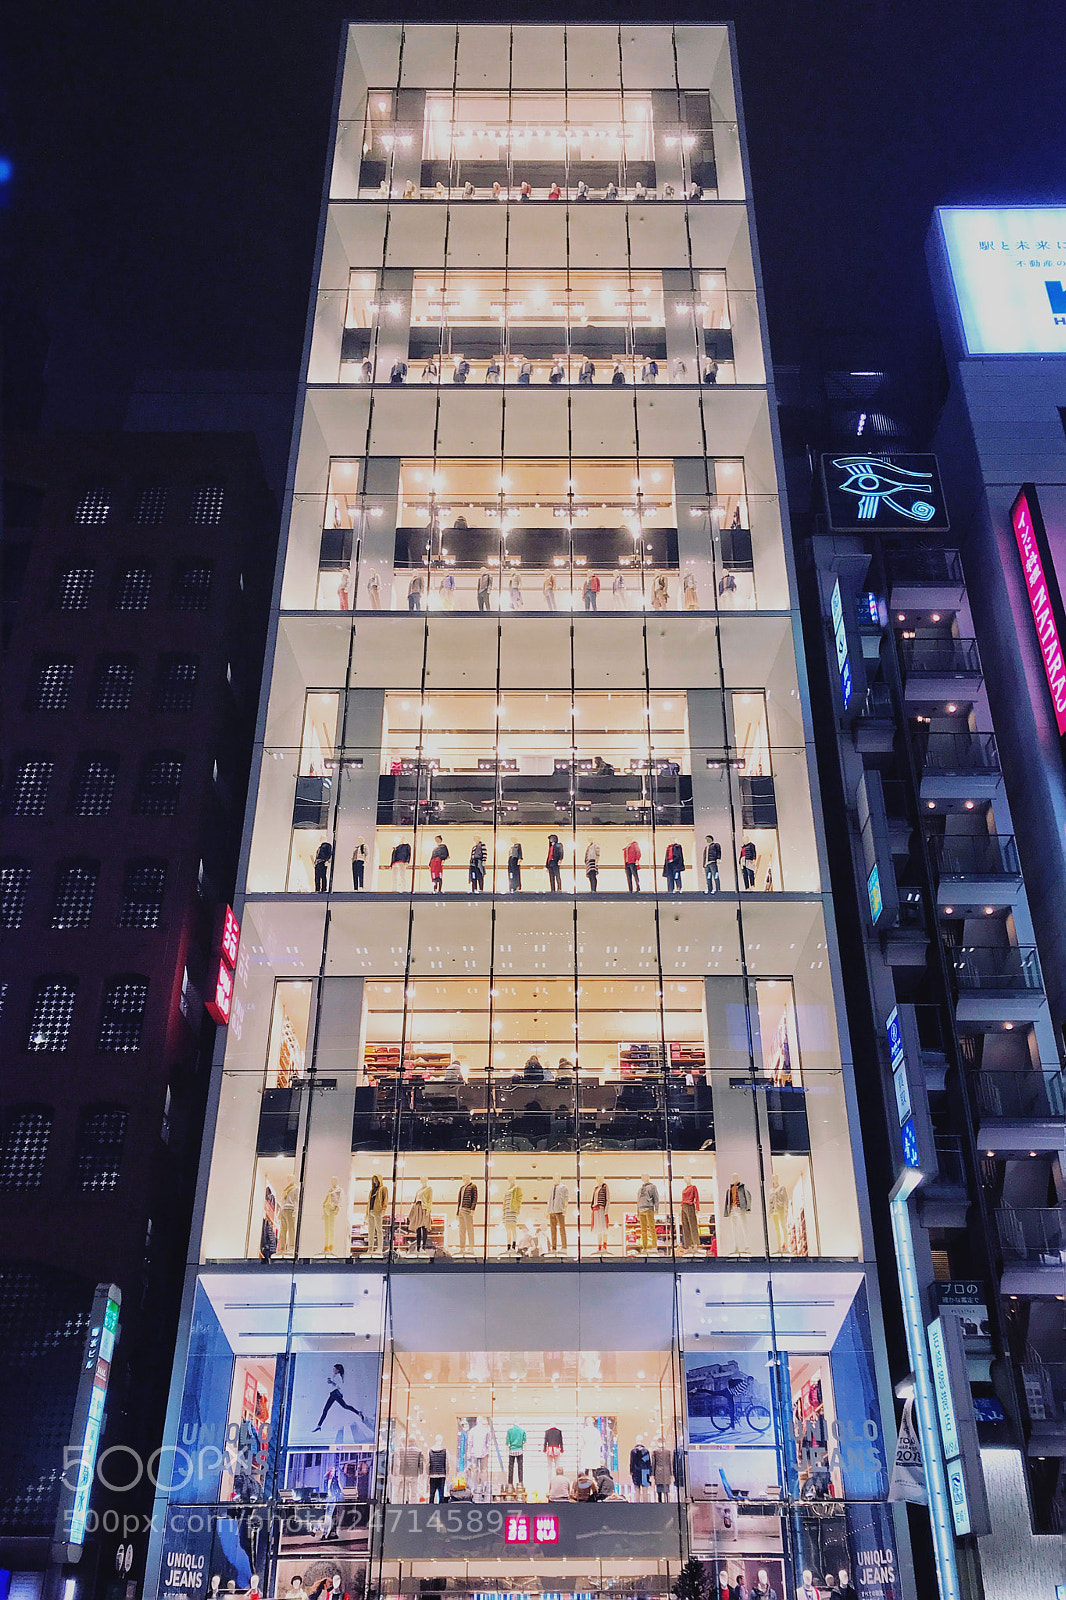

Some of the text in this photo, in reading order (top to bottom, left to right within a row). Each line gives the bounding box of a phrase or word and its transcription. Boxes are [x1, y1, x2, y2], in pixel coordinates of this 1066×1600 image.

[1032, 585, 1066, 713] NATARAJ
[941, 1283, 978, 1295] プロの
[167, 1552, 205, 1570] UNIQLO
[857, 1549, 893, 1567] UNIQLO
[165, 1570, 203, 1589] JEANS
[860, 1566, 896, 1585] JEANS
